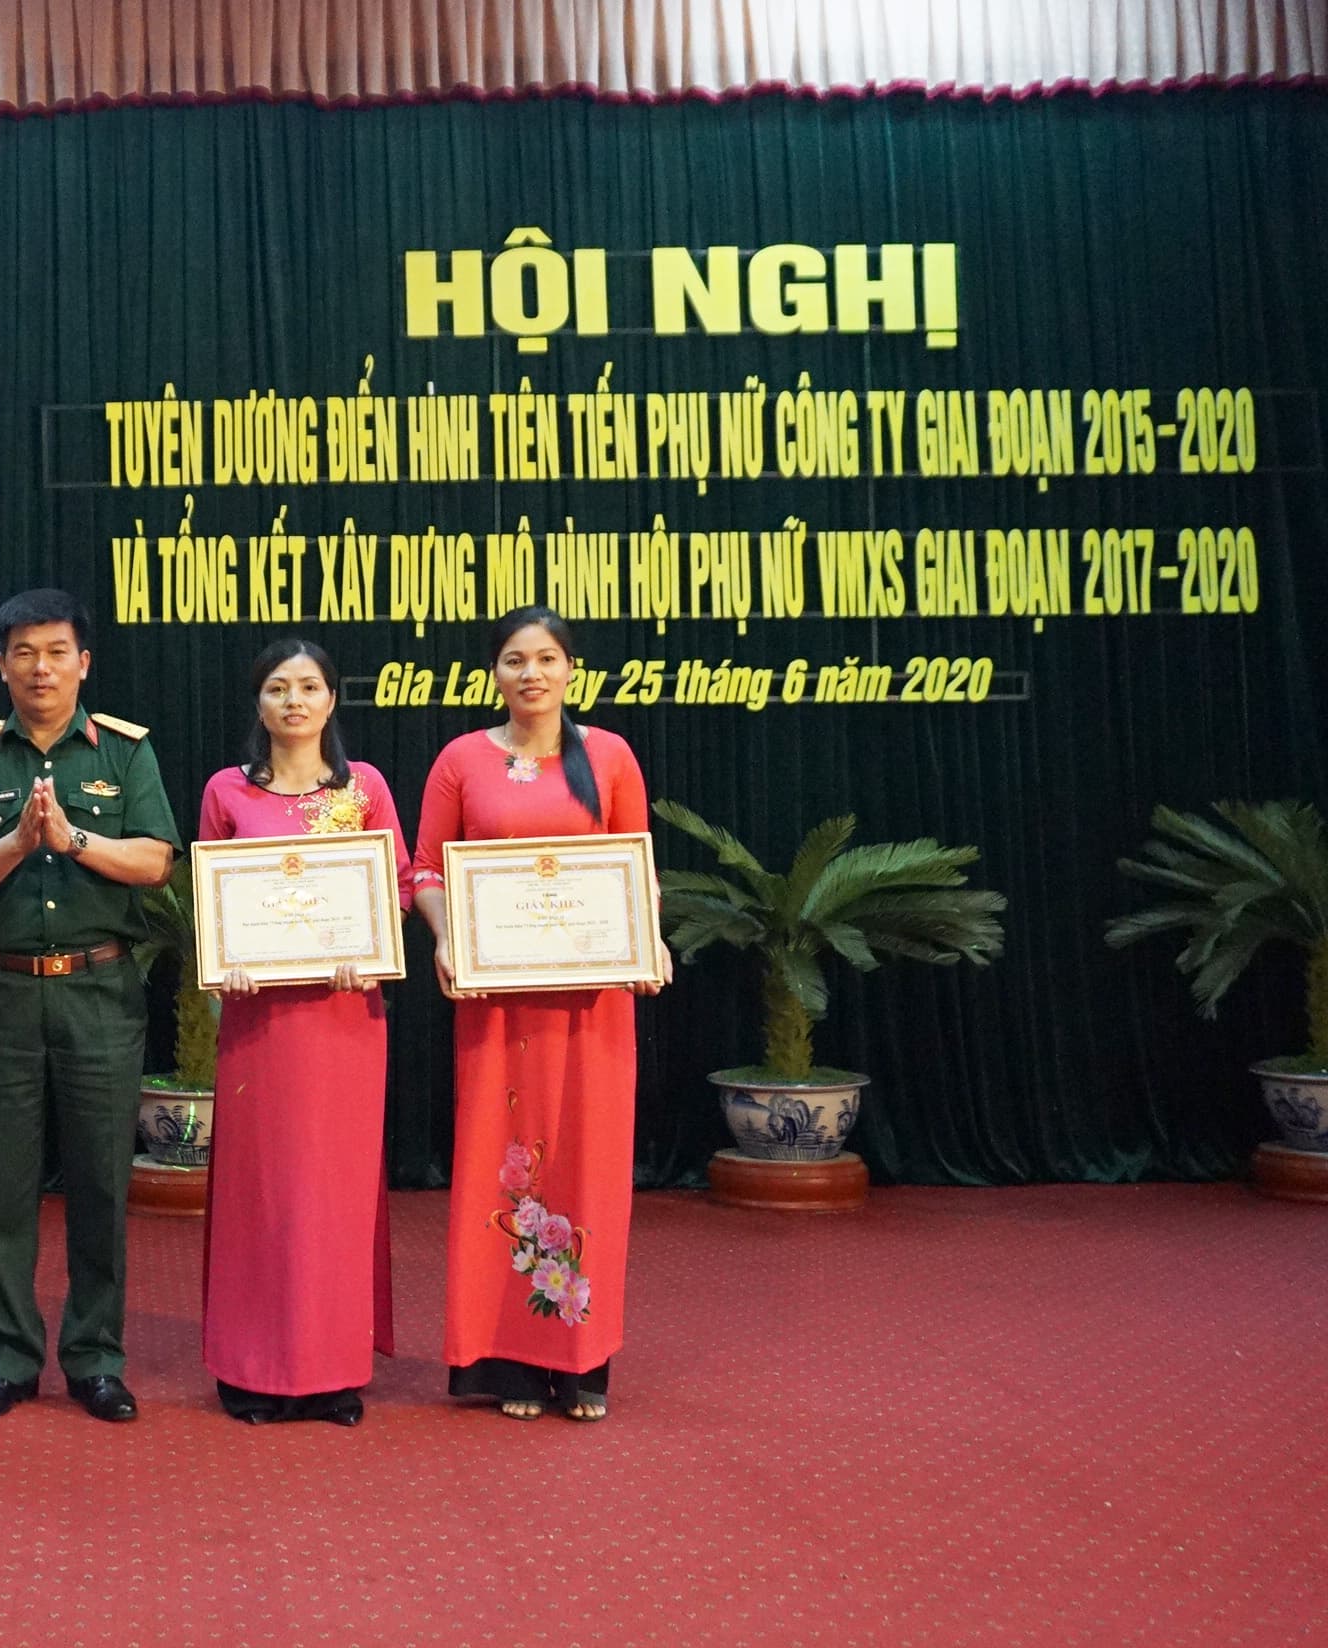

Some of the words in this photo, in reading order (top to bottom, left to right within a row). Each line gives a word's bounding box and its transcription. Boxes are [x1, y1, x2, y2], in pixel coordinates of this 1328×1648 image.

[405, 226, 609, 353] HỘI
[651, 243, 958, 348] NGHỊ
[105, 382, 203, 489] TUYÊN
[213, 388, 318, 486] DƯƠNG
[326, 354, 399, 483] ĐIỂN
[407, 381, 480, 482] HÌNH
[489, 376, 561, 482] TIÊN
[567, 361, 639, 480] TIẾN
[646, 391, 711, 496] PHỤ
[719, 375, 766, 479] NỮ
[775, 371, 860, 479] CÔNG
[866, 390, 906, 477] TY
[916, 388, 980, 477] GIAI
[988, 388, 1075, 492] ĐOẠN
[1083, 387, 1256, 475] 2015-2020
[111, 519, 151, 624] VÀ
[157, 493, 239, 624] TỔNG
[249, 504, 307, 623] KẾT
[317, 517, 378, 622] XÂY
[389, 525, 477, 638] DỰNG
[486, 515, 536, 621] MÔ
[546, 516, 620, 620] HÌNH
[629, 513, 681, 635] HỘI
[689, 531, 752, 636] PHỤ
[759, 515, 807, 619] NỮ
[817, 528, 906, 618] VMXS
[915, 527, 978, 617] GIAI
[985, 528, 1071, 633] ĐOẠN
[374, 661, 434, 708] Gia
[565, 658, 608, 712] ày
[613, 659, 666, 705] 25
[674, 659, 774, 711] tháng
[781, 658, 808, 704] 6
[814, 656, 897, 703] năm
[900, 656, 993, 703] 2020
